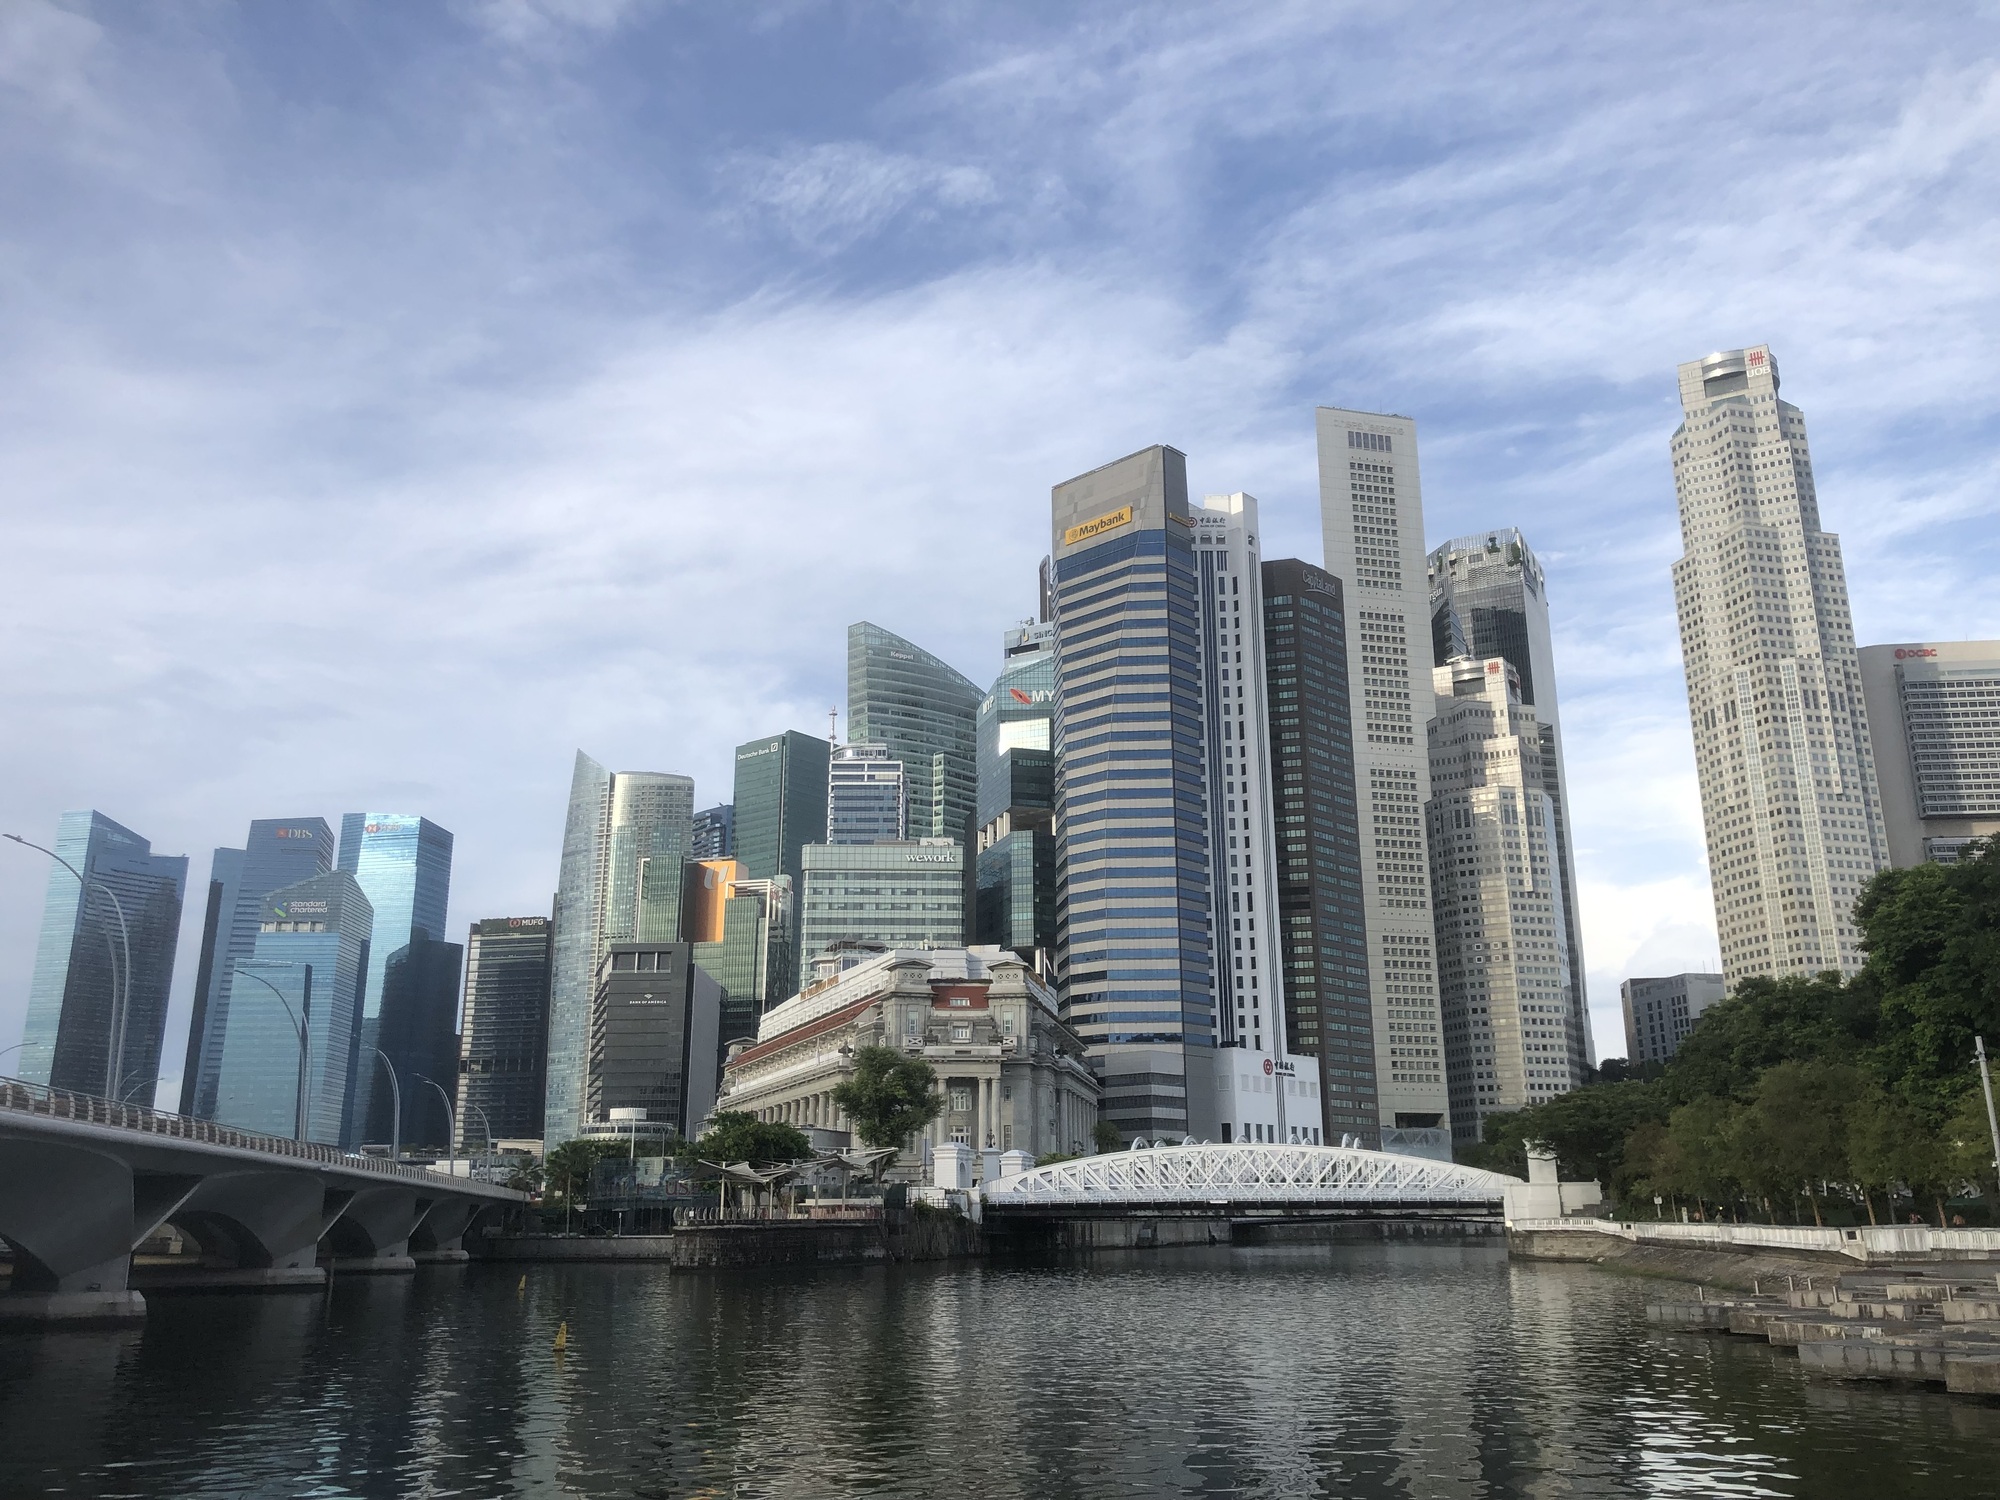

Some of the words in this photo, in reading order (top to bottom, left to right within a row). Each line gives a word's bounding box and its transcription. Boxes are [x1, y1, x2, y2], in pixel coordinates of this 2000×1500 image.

[1746, 366, 1771, 378] UOB
[1079, 511, 1125, 537] Maybank
[890, 650, 914, 660] Keppel
[1907, 649, 1938, 658] OCBC
[737, 751, 759, 760] Deutsche
[759, 747, 770, 755] Bank
[288, 828, 313, 839] DBS
[905, 850, 955, 862] wework
[521, 918, 544, 926] MUFG
